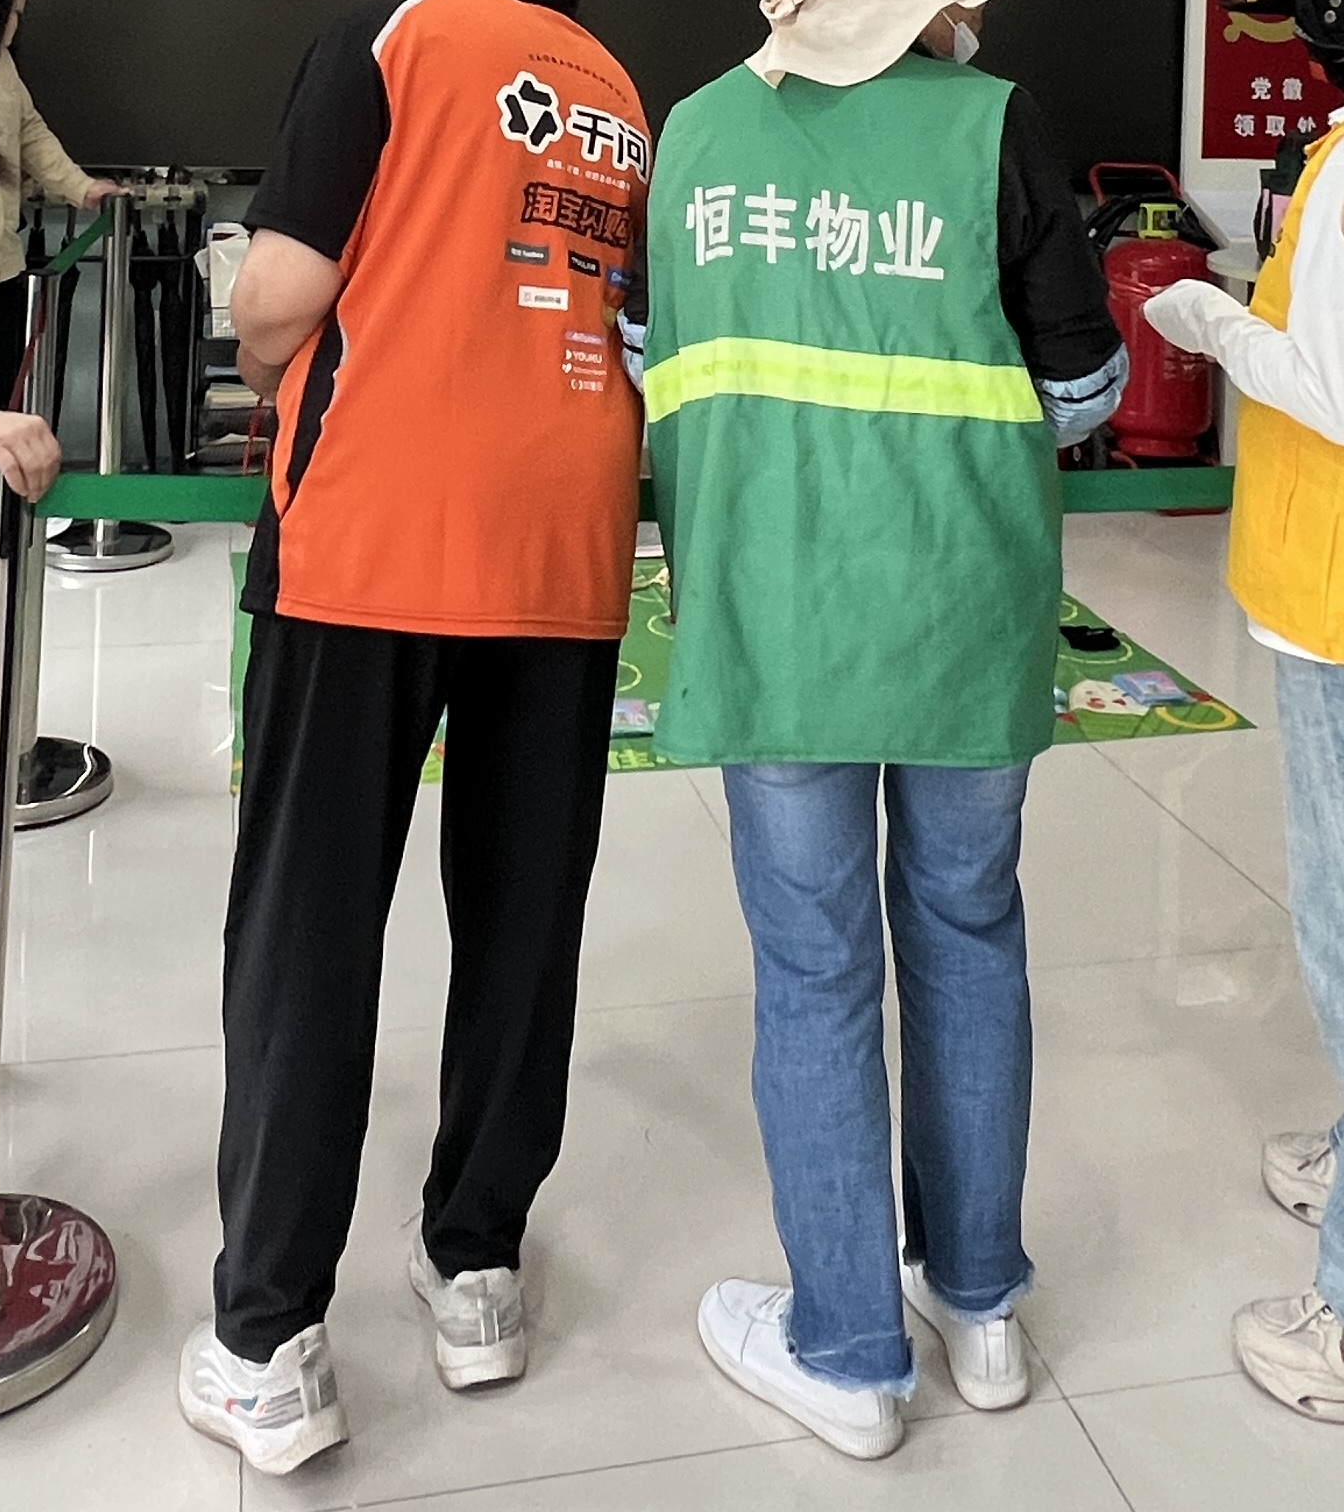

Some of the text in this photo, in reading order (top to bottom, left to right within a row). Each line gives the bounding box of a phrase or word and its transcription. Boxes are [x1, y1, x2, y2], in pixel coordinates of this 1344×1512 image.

[570, 107, 649, 179] 千问
[523, 182, 632, 247] 淘宝闪购
[685, 183, 944, 281] 恒丰物业
